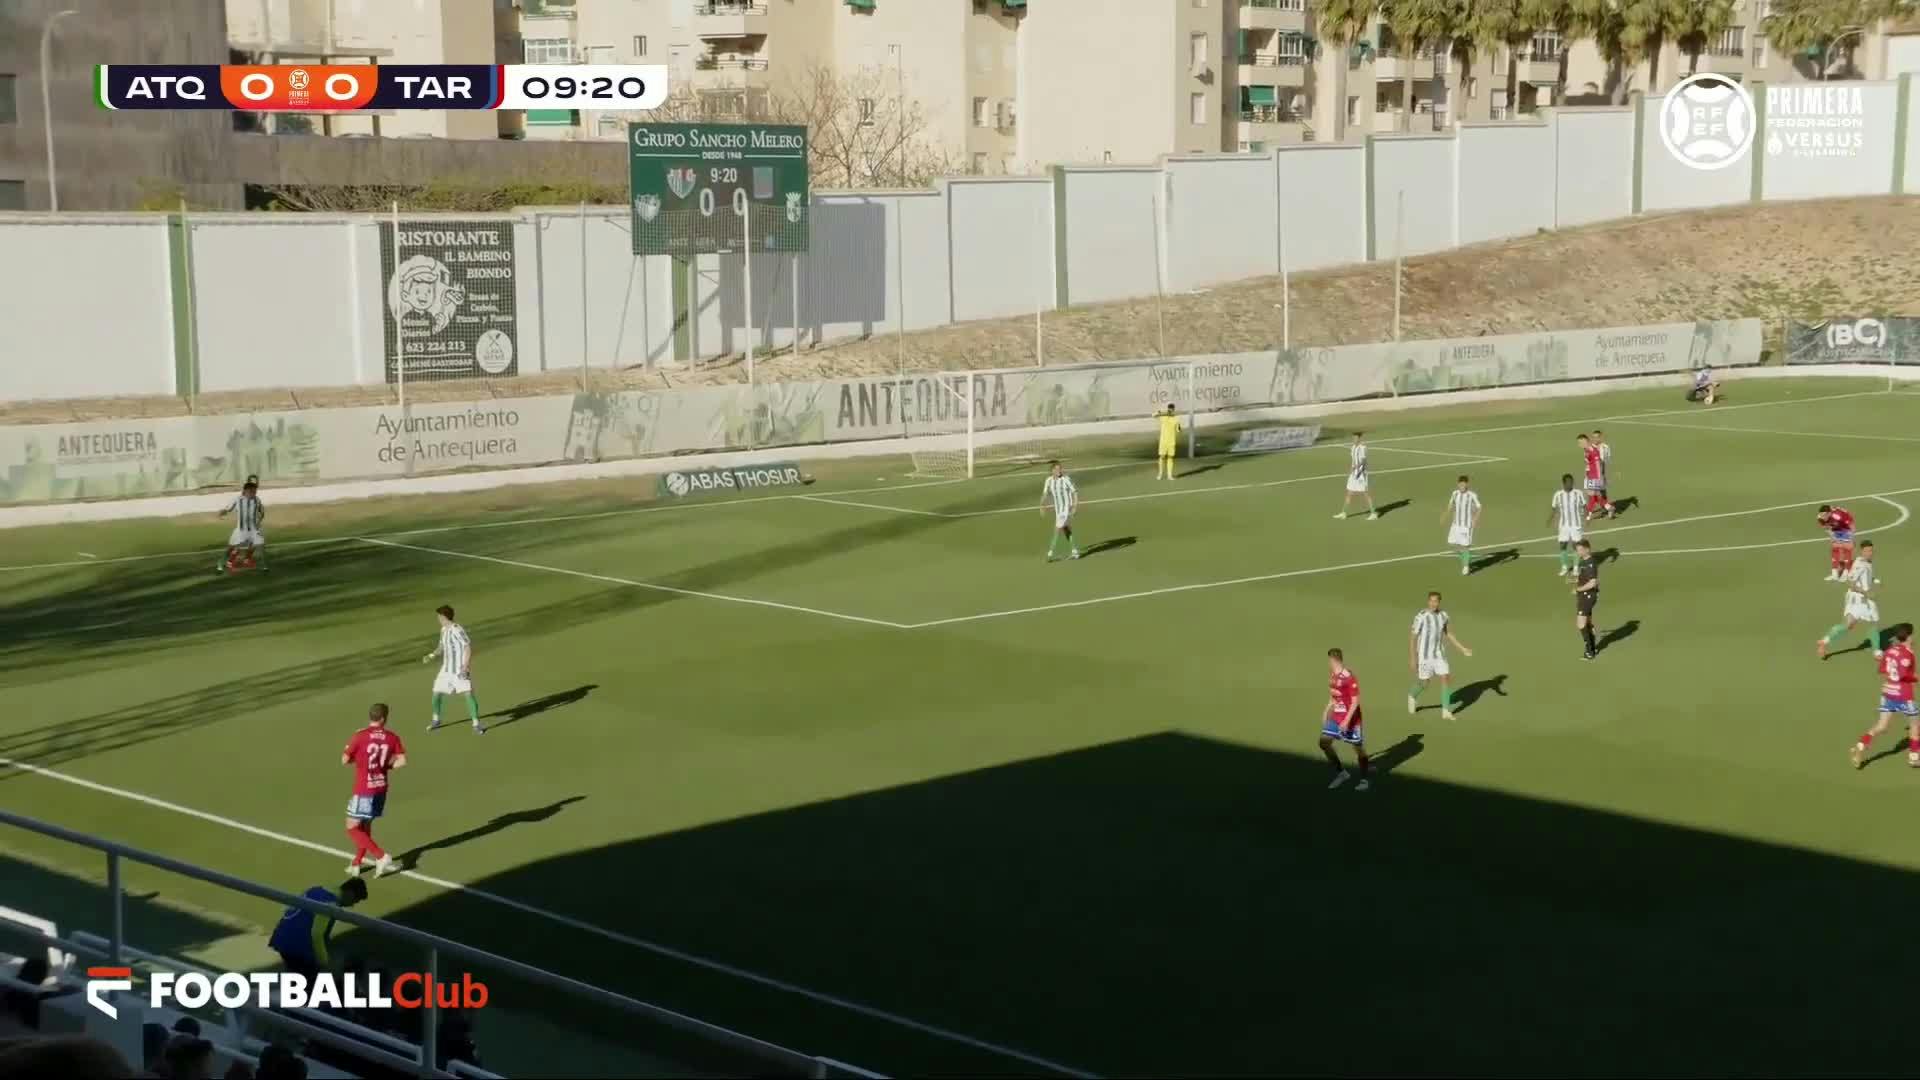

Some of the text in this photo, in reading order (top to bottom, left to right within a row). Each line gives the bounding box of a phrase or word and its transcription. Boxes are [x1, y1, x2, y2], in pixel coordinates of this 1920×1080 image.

[634, 128, 804, 149] GRUPO SANCHO MELERO
[702, 151, 725, 160] DESDE
[710, 168, 738, 183] 9:20
[699, 187, 748, 217] 0 0
[398, 231, 499, 246] RISTORANTE
[444, 250, 511, 262] IL BAMBINO
[466, 267, 511, 279] BIONDO
[406, 340, 466, 352] 623 224 213
[1594, 332, 1668, 352] Ayuntamiento
[836, 373, 1008, 428] ANTEQUERA
[1172, 385, 1241, 403] Anequera
[376, 408, 520, 440] Ayuntamiento
[57, 432, 157, 456] ANTEQUERA
[378, 438, 517, 463] de Antequera
[366, 743, 390, 769] 21
